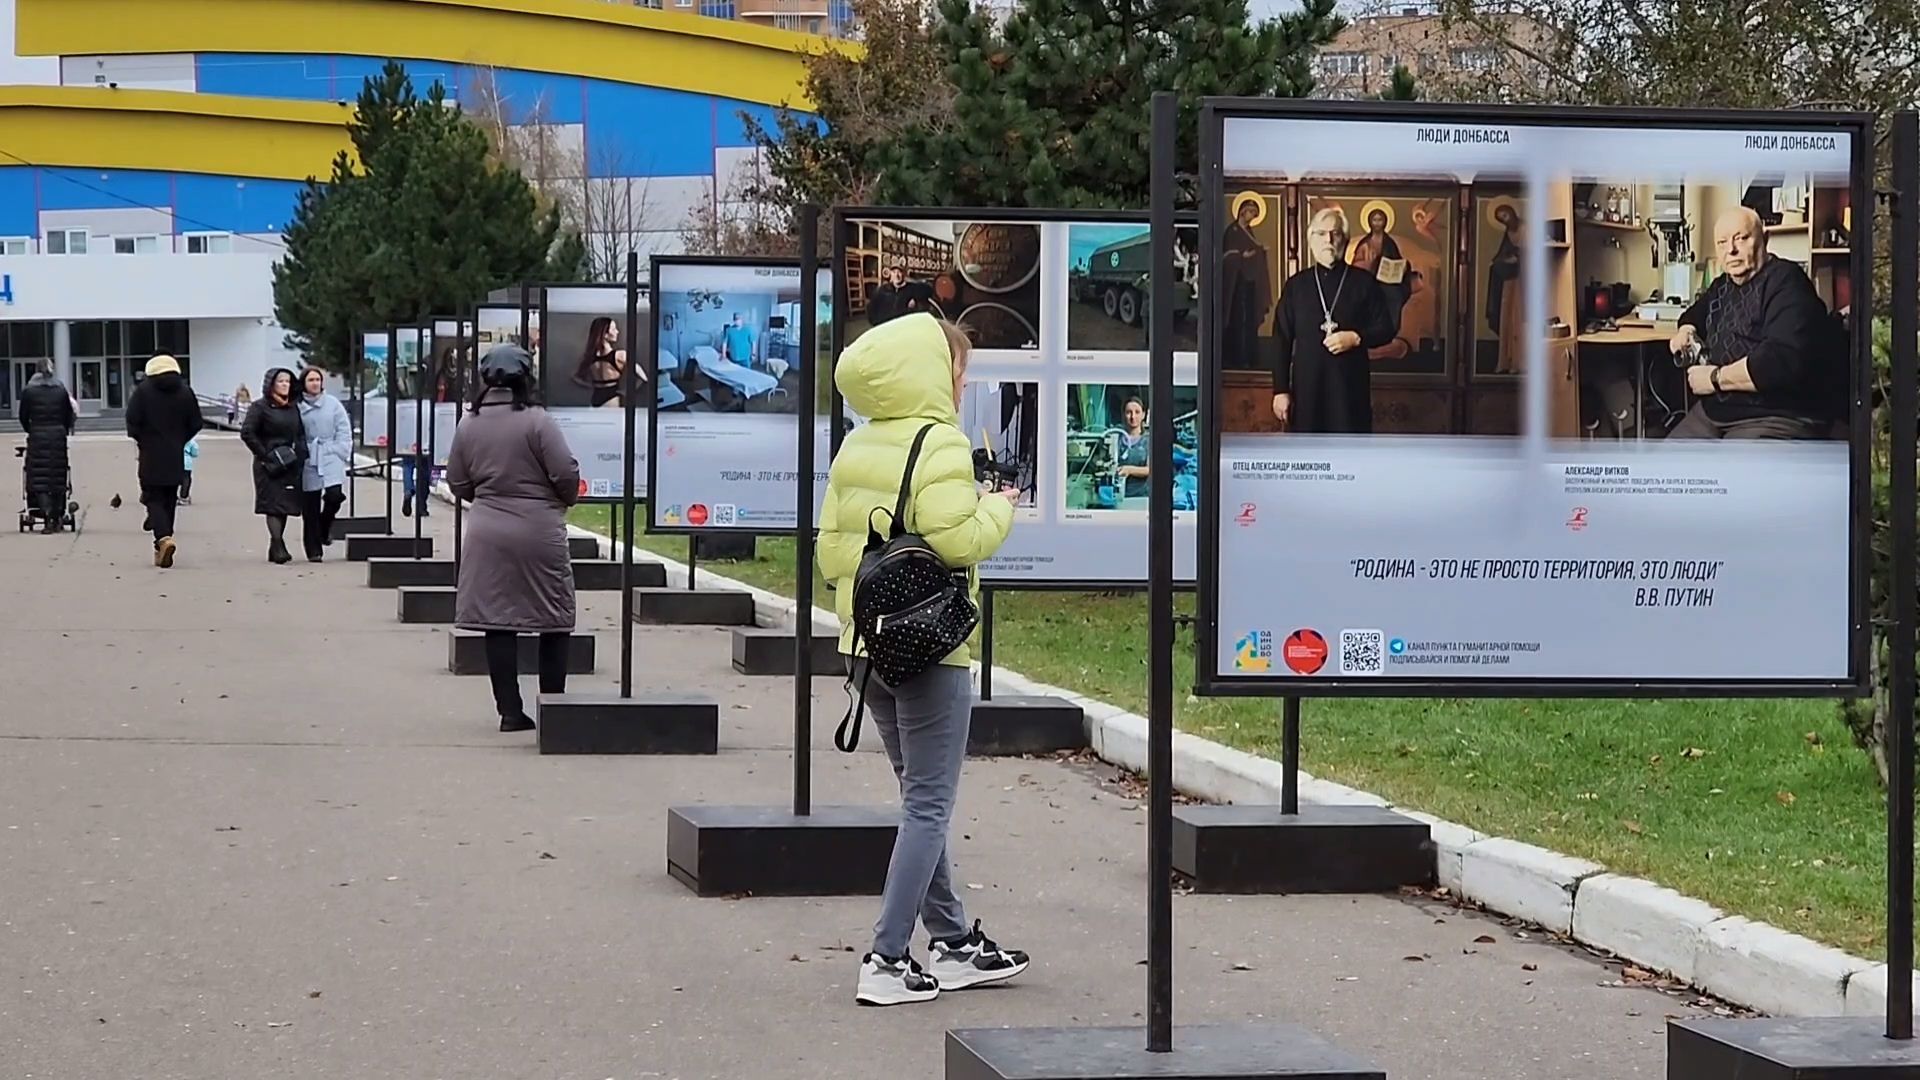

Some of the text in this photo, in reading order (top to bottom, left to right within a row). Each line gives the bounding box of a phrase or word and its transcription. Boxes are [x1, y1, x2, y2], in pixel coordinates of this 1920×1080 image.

[1416, 128, 1510, 144] ЛЮДИ ДОНБАССА
[1745, 135, 1836, 151] ЛЮДИ ДОНБАССА
[1232, 462, 1331, 472] ОТЕЦ АЛЕКСАНДР НАМОКОНОВ
[1565, 466, 1630, 476] АЛЕКСАНДР ВИТКОВ
[1429, 559, 1458, 579] ЭТО
[1460, 559, 1481, 579] НЕ
[1483, 560, 1540, 579] ПРОСТО
[1543, 560, 1636, 581] ТЕРРИТОРИЯ,
[1640, 561, 1669, 580] ЭТО
[1635, 588, 1714, 607] В.В. ПУТИН
[1407, 641, 1541, 652] КАНАЛ ПУНКТА ГУМАНИТАРНОЙ ПОМОЩИ
[1389, 654, 1510, 665] ПОДПИСЫВАЙСЯ И ПОМОГАЙ ДЕЛАМИ
